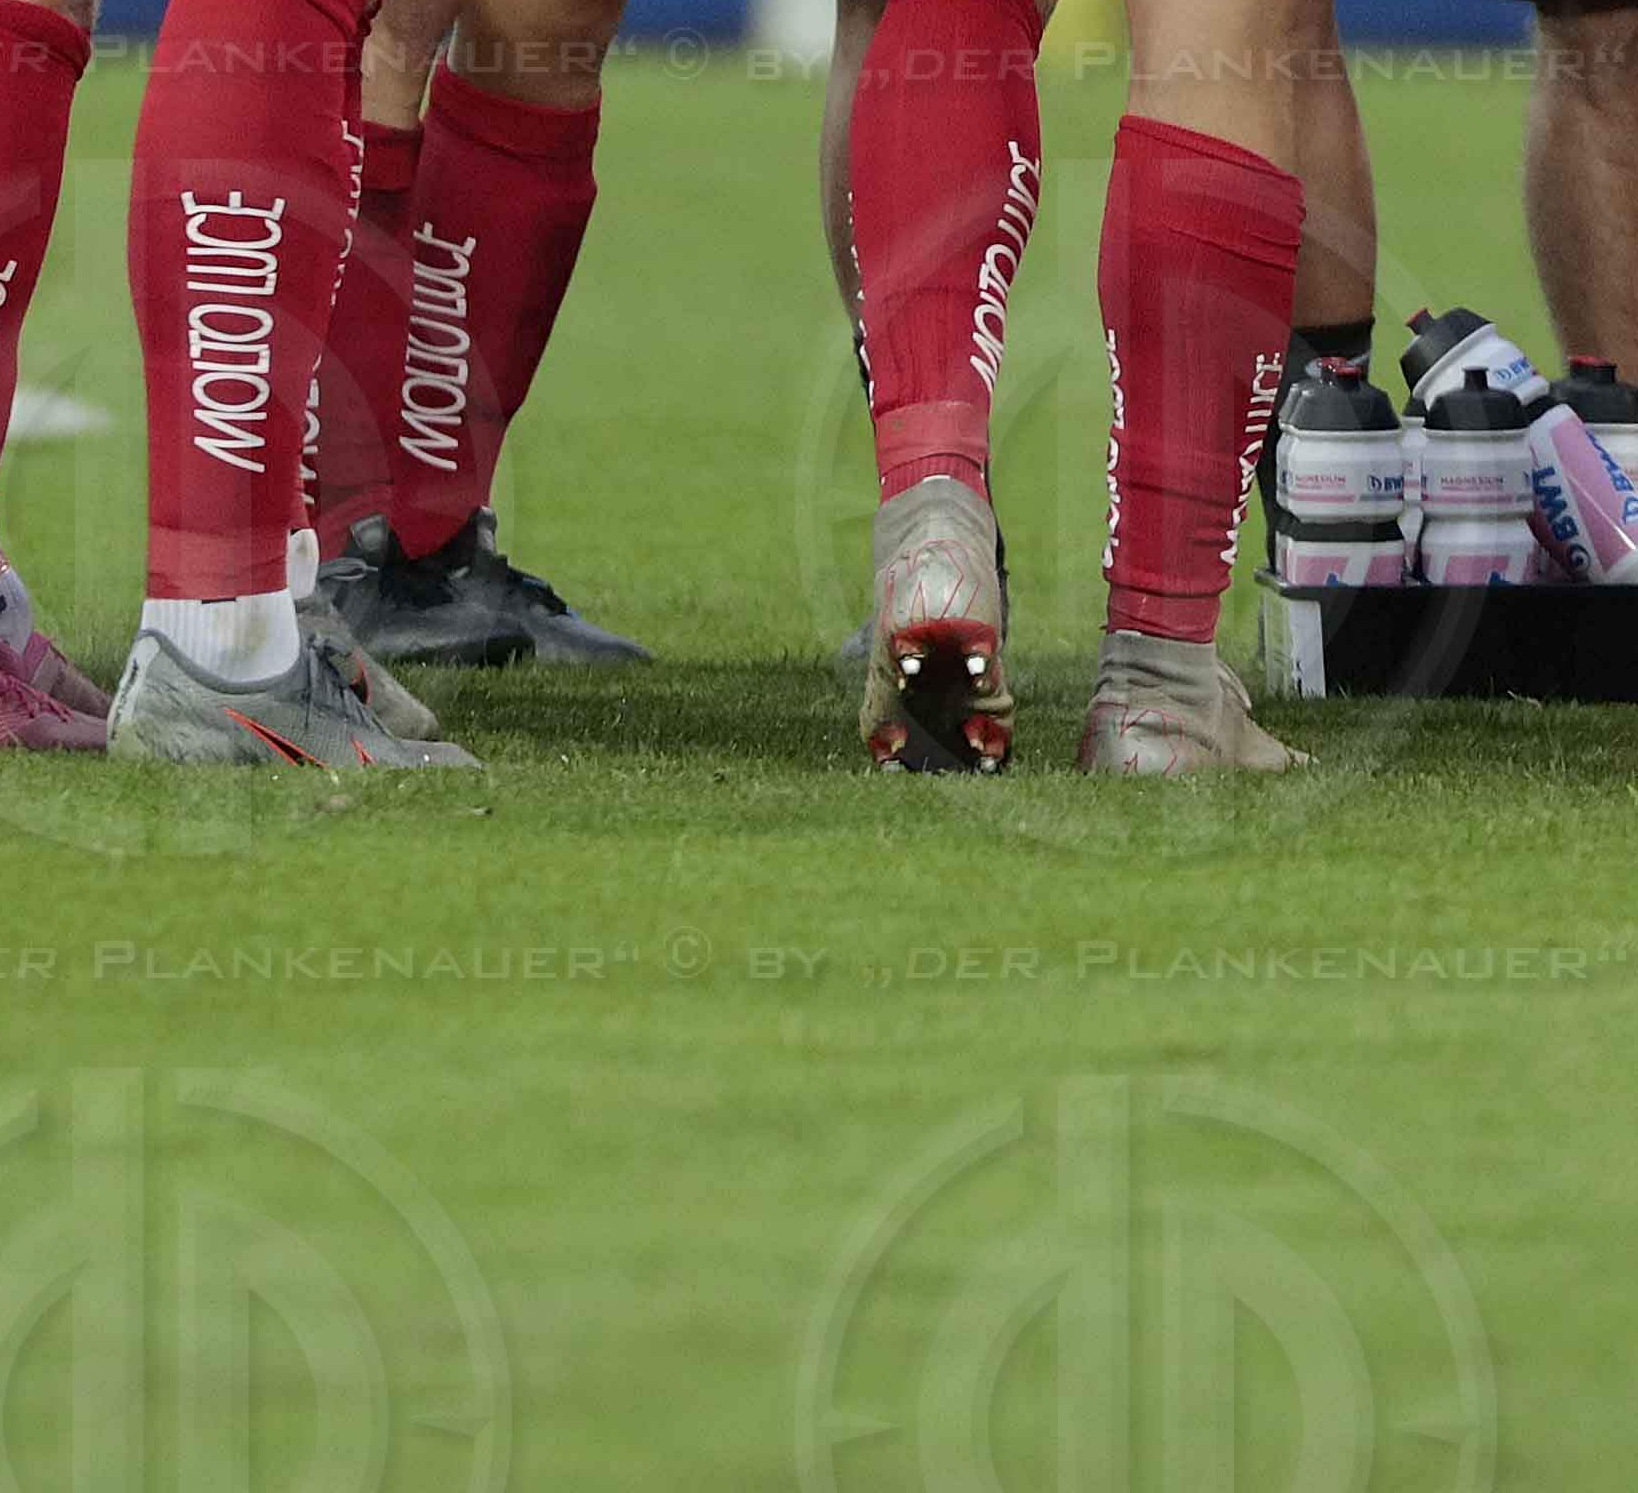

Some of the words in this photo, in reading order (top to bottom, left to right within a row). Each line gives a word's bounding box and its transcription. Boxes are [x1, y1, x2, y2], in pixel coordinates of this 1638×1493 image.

[181, 190, 288, 297] LUCE
[411, 222, 478, 320] LUCE
[187, 301, 277, 474] MOLTO
[397, 313, 470, 473] MOLTO
